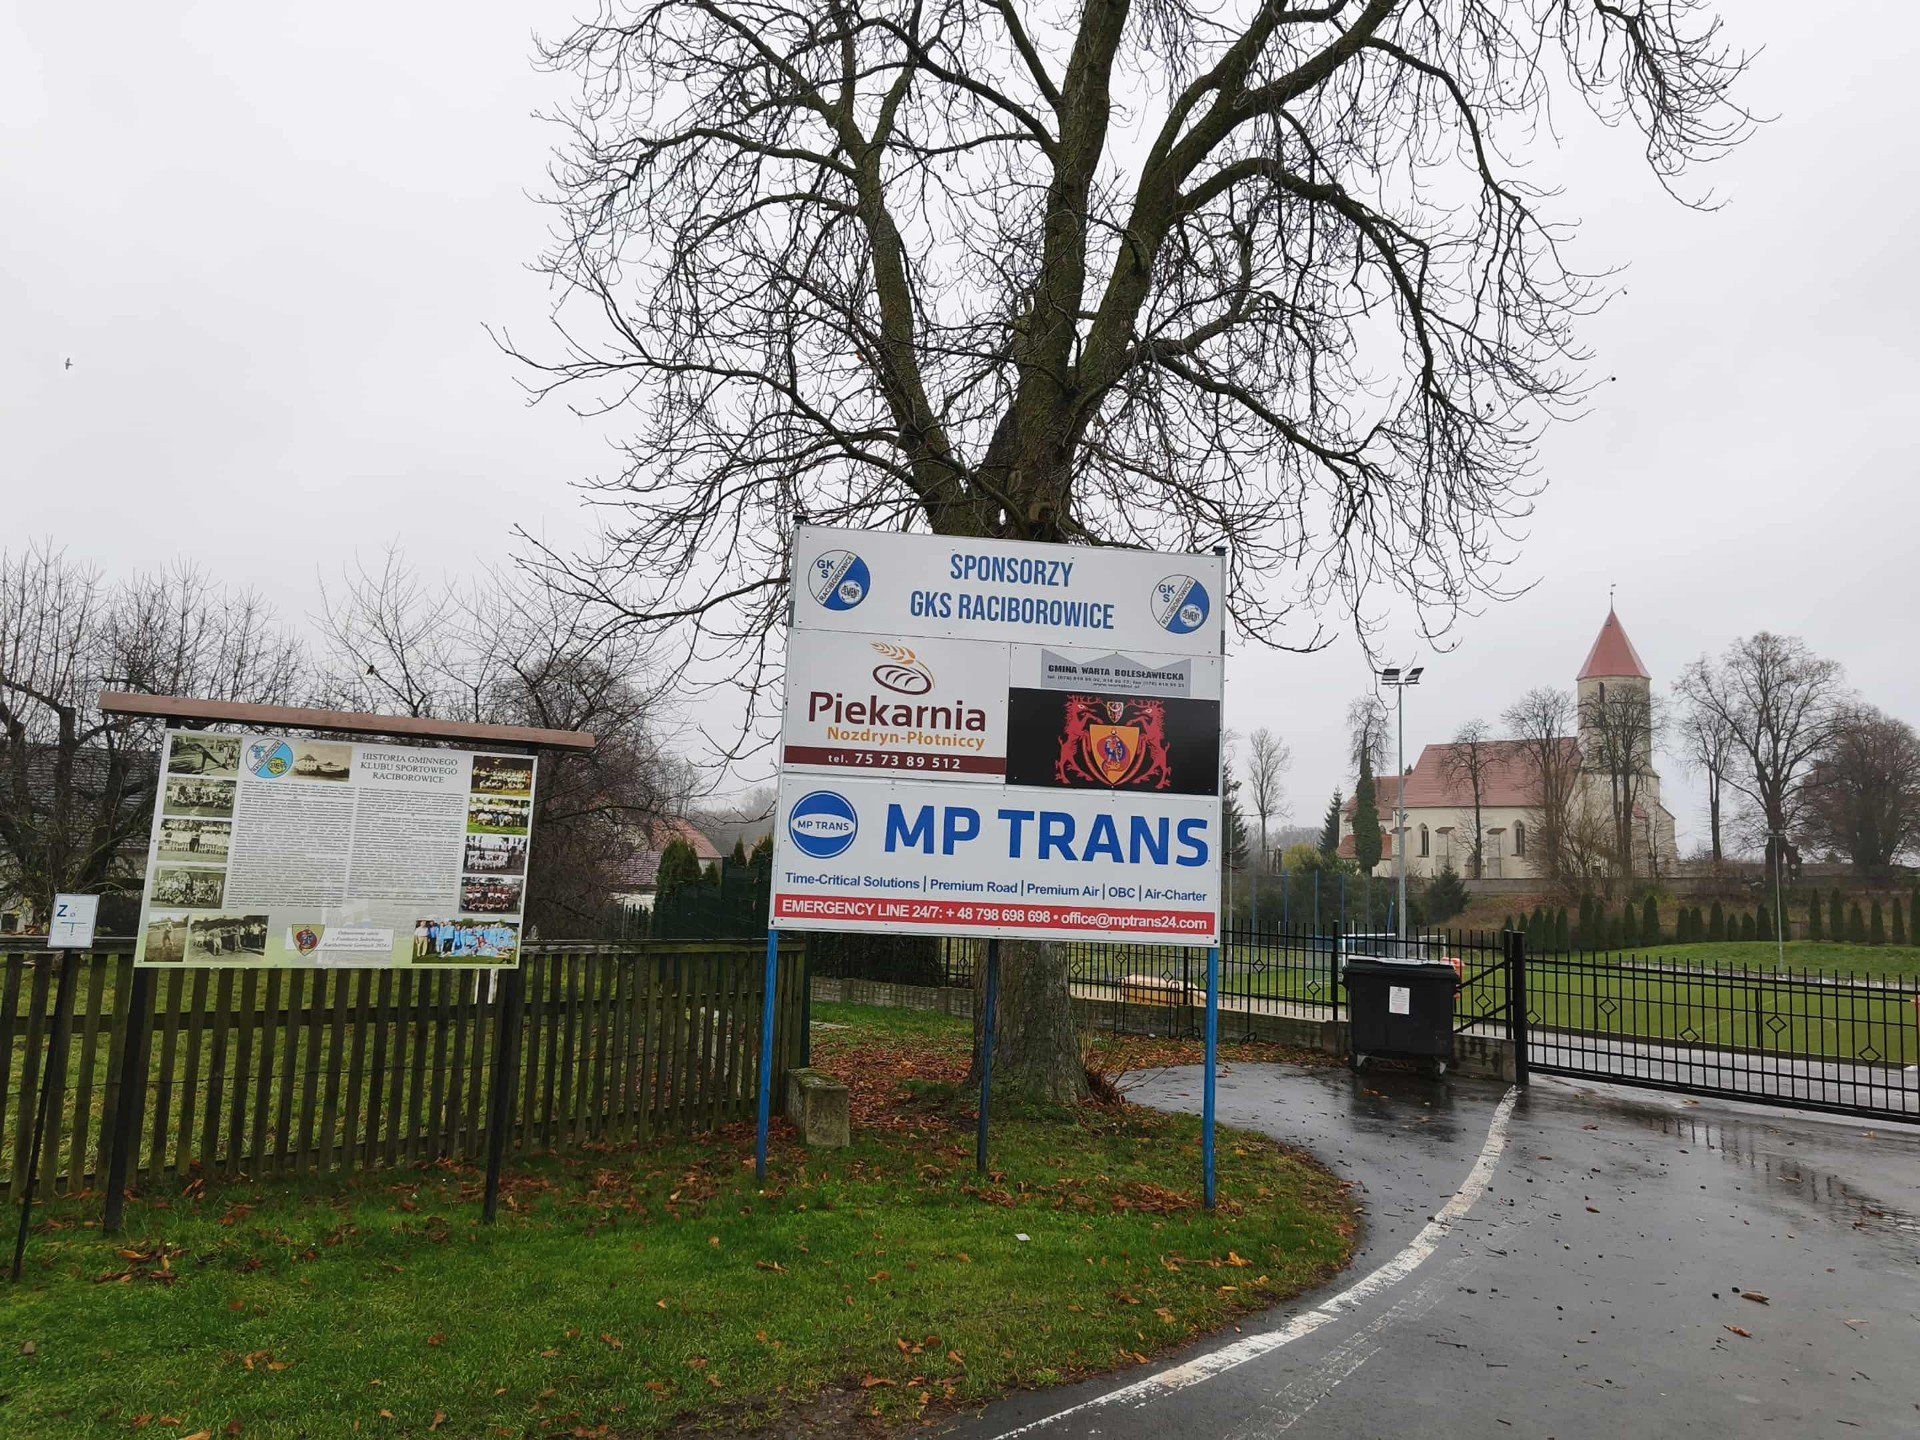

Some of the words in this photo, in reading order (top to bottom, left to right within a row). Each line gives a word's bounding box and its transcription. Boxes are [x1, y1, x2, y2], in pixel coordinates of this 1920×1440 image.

[818, 554, 855, 601] RACIBOROWICE
[950, 553, 1074, 588] SPONSORZY
[910, 590, 952, 618] GKS
[958, 593, 1115, 630] RACIBOROWICE
[1048, 664, 1078, 674] GMINA
[1081, 666, 1111, 676] WARTA
[1114, 668, 1185, 681] BOLESŁAWIECKA
[808, 691, 986, 732] Piekarnia
[827, 726, 986, 752] Nozdryn-Płotniccy
[362, 752, 406, 763] HISTORIA
[408, 755, 458, 767] GMINNEGO
[828, 754, 849, 764] tel.
[854, 753, 874, 765] 75
[880, 754, 899, 766] 73
[906, 755, 926, 768] 89
[932, 757, 961, 770] 512
[360, 761, 394, 772] KLUBU
[395, 764, 458, 776] SPORTOWEGO
[372, 771, 446, 784] RACIBOROWICE
[797, 820, 813, 829] MP
[815, 821, 850, 831] TRANS
[884, 803, 981, 856] MP
[998, 808, 1209, 867] TRANS
[785, 872, 861, 887] Time-Critical
[863, 875, 920, 890] Solutions
[930, 878, 984, 892] Premium
[987, 881, 1018, 893] Road
[1027, 883, 1080, 896] Premium
[1082, 885, 1100, 897] Air
[1108, 886, 1136, 899] OBC
[1144, 888, 1208, 902] Air-Charter
[782, 899, 878, 917] EMERGENCY
[878, 903, 910, 918] LINE
[912, 905, 943, 919] 24/7:
[957, 907, 973, 920] 48
[976, 908, 999, 921] 798
[1001, 909, 1025, 922] 698
[1027, 910, 1051, 923] 698
[1061, 911, 1207, 930] office@mptrans24.com
